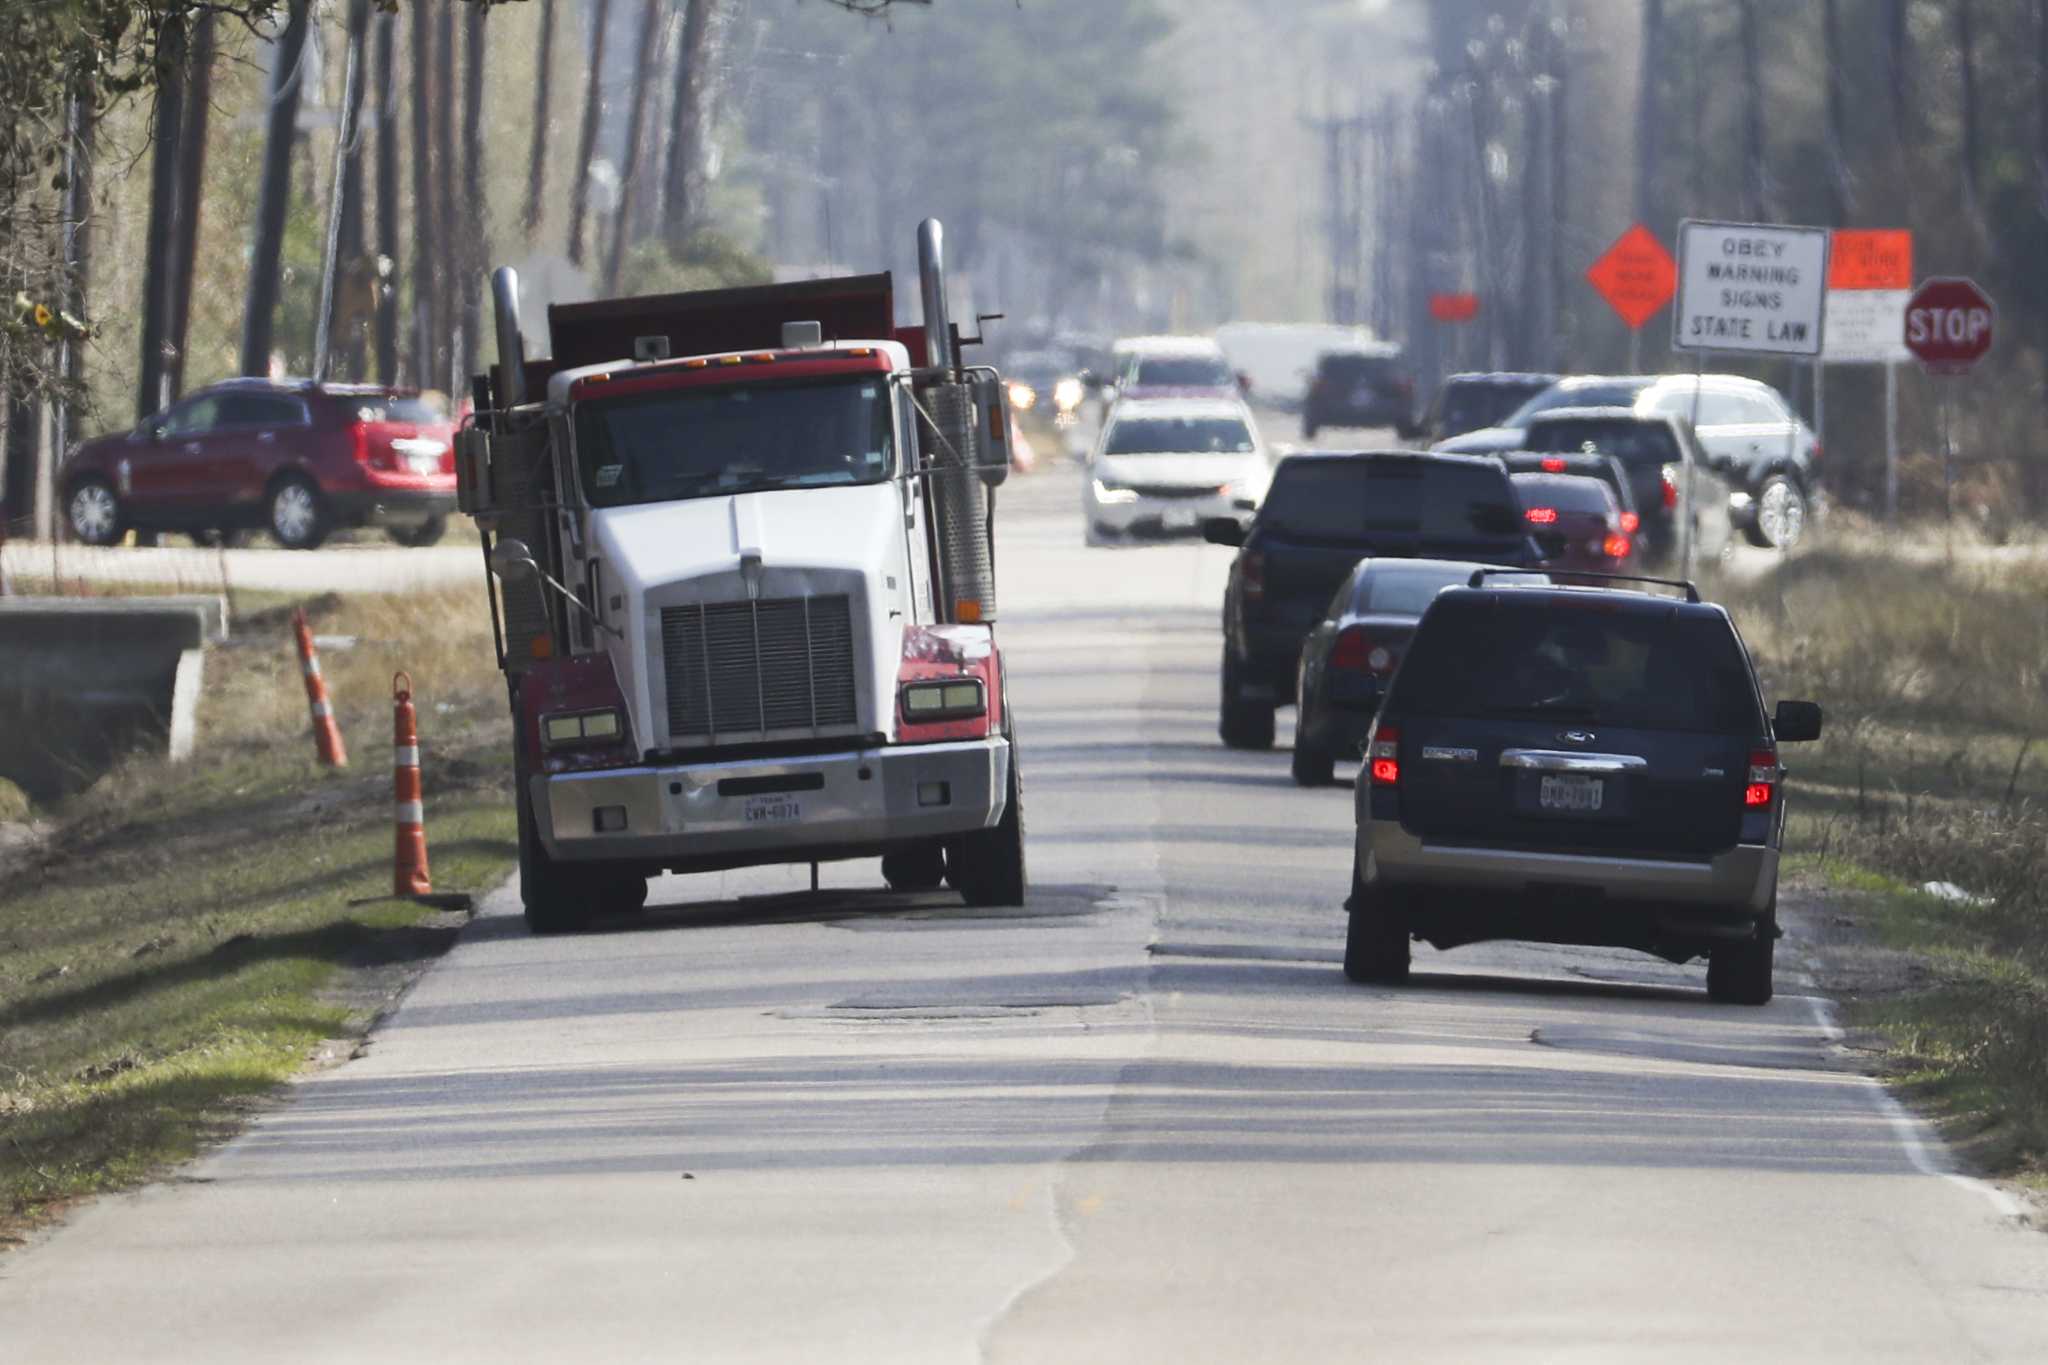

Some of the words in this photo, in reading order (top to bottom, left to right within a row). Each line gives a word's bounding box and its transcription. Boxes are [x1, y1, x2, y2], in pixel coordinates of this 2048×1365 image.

[1721, 237, 1786, 257] OBEY
[1706, 263, 1800, 286] WARNING
[1720, 288, 1783, 310] SIGNS
[1691, 315, 1752, 338] STATE
[1767, 320, 1808, 342] LAW
[1909, 307, 1990, 343] STOP
